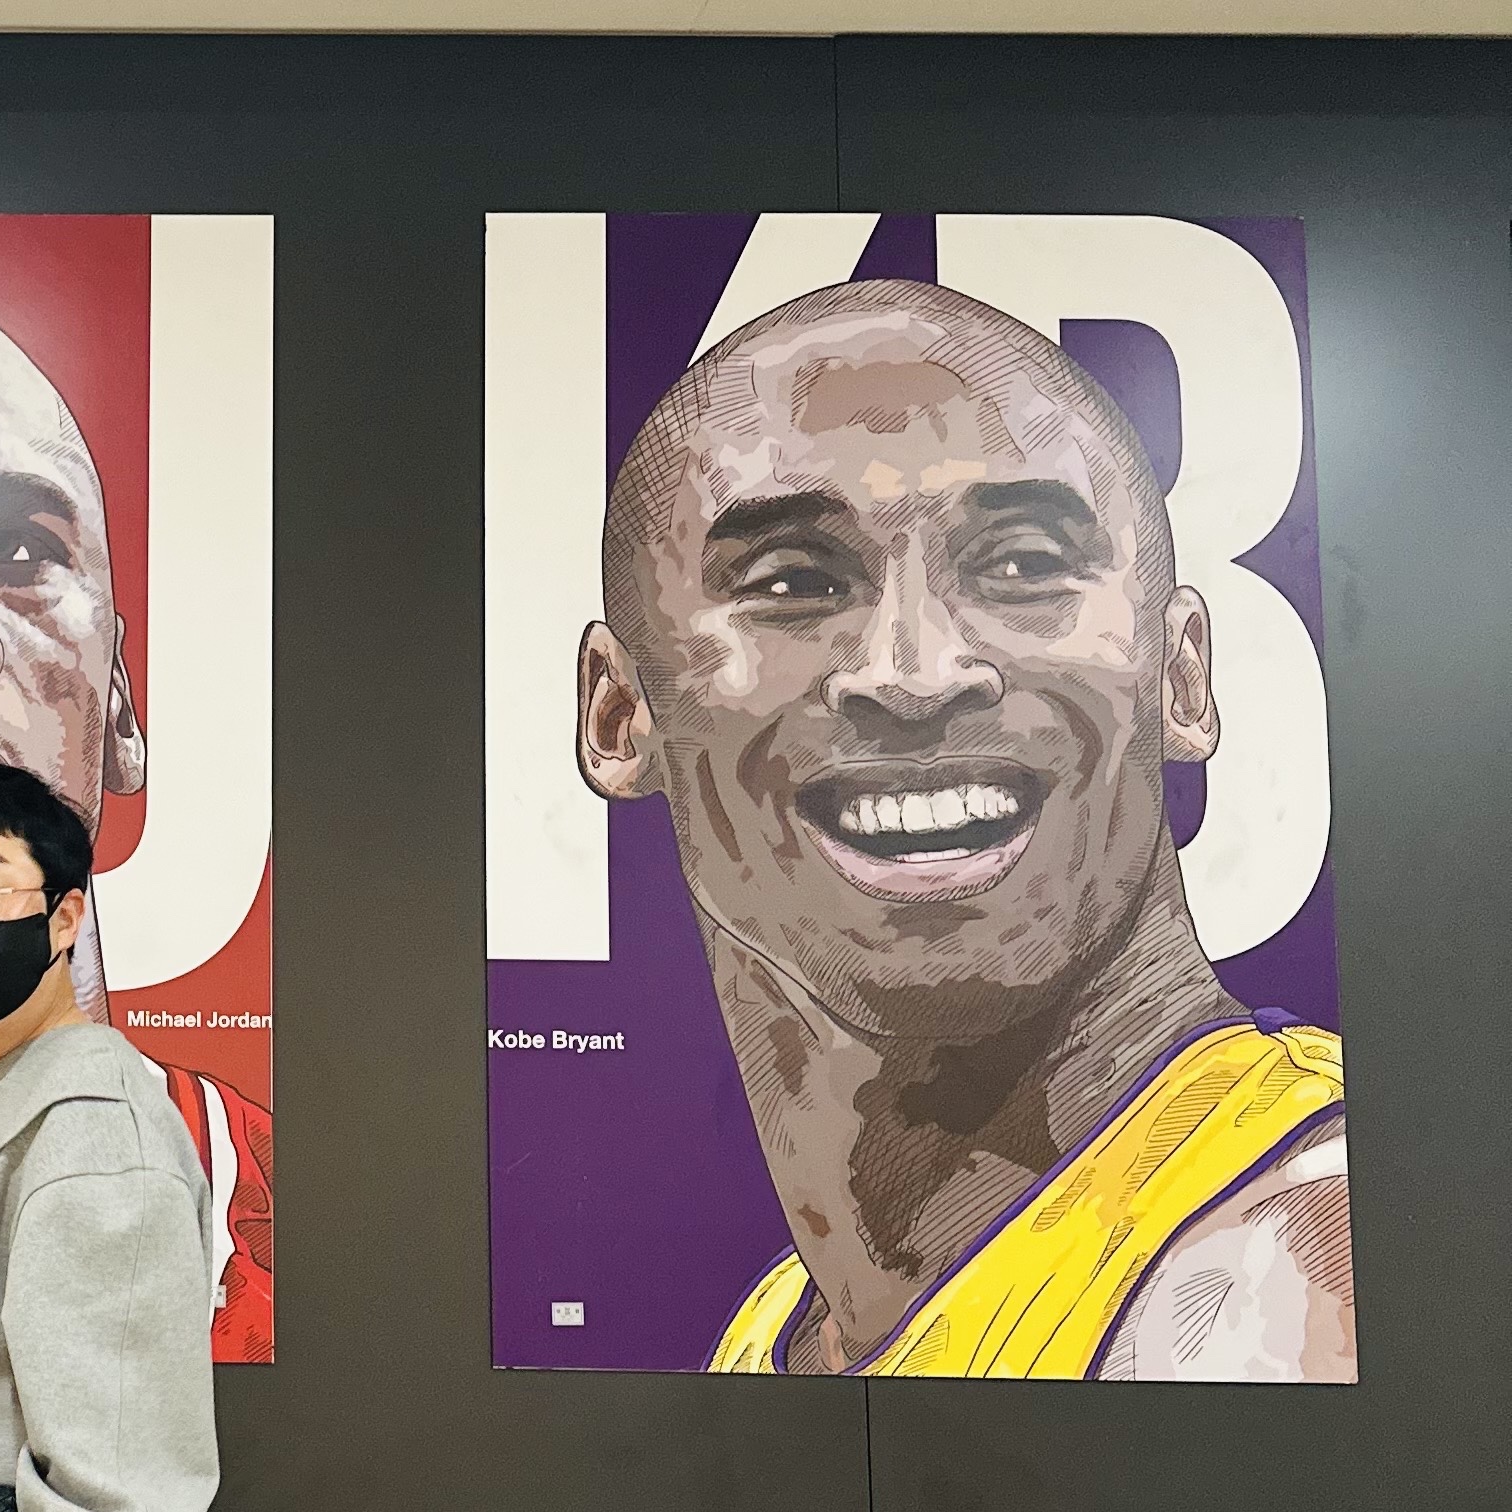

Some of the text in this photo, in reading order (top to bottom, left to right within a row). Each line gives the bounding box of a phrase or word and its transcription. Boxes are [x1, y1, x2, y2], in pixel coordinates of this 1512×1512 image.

[127, 1010, 273, 1029] Michael Jordan
[488, 1029, 624, 1053] Kobe Bryant
